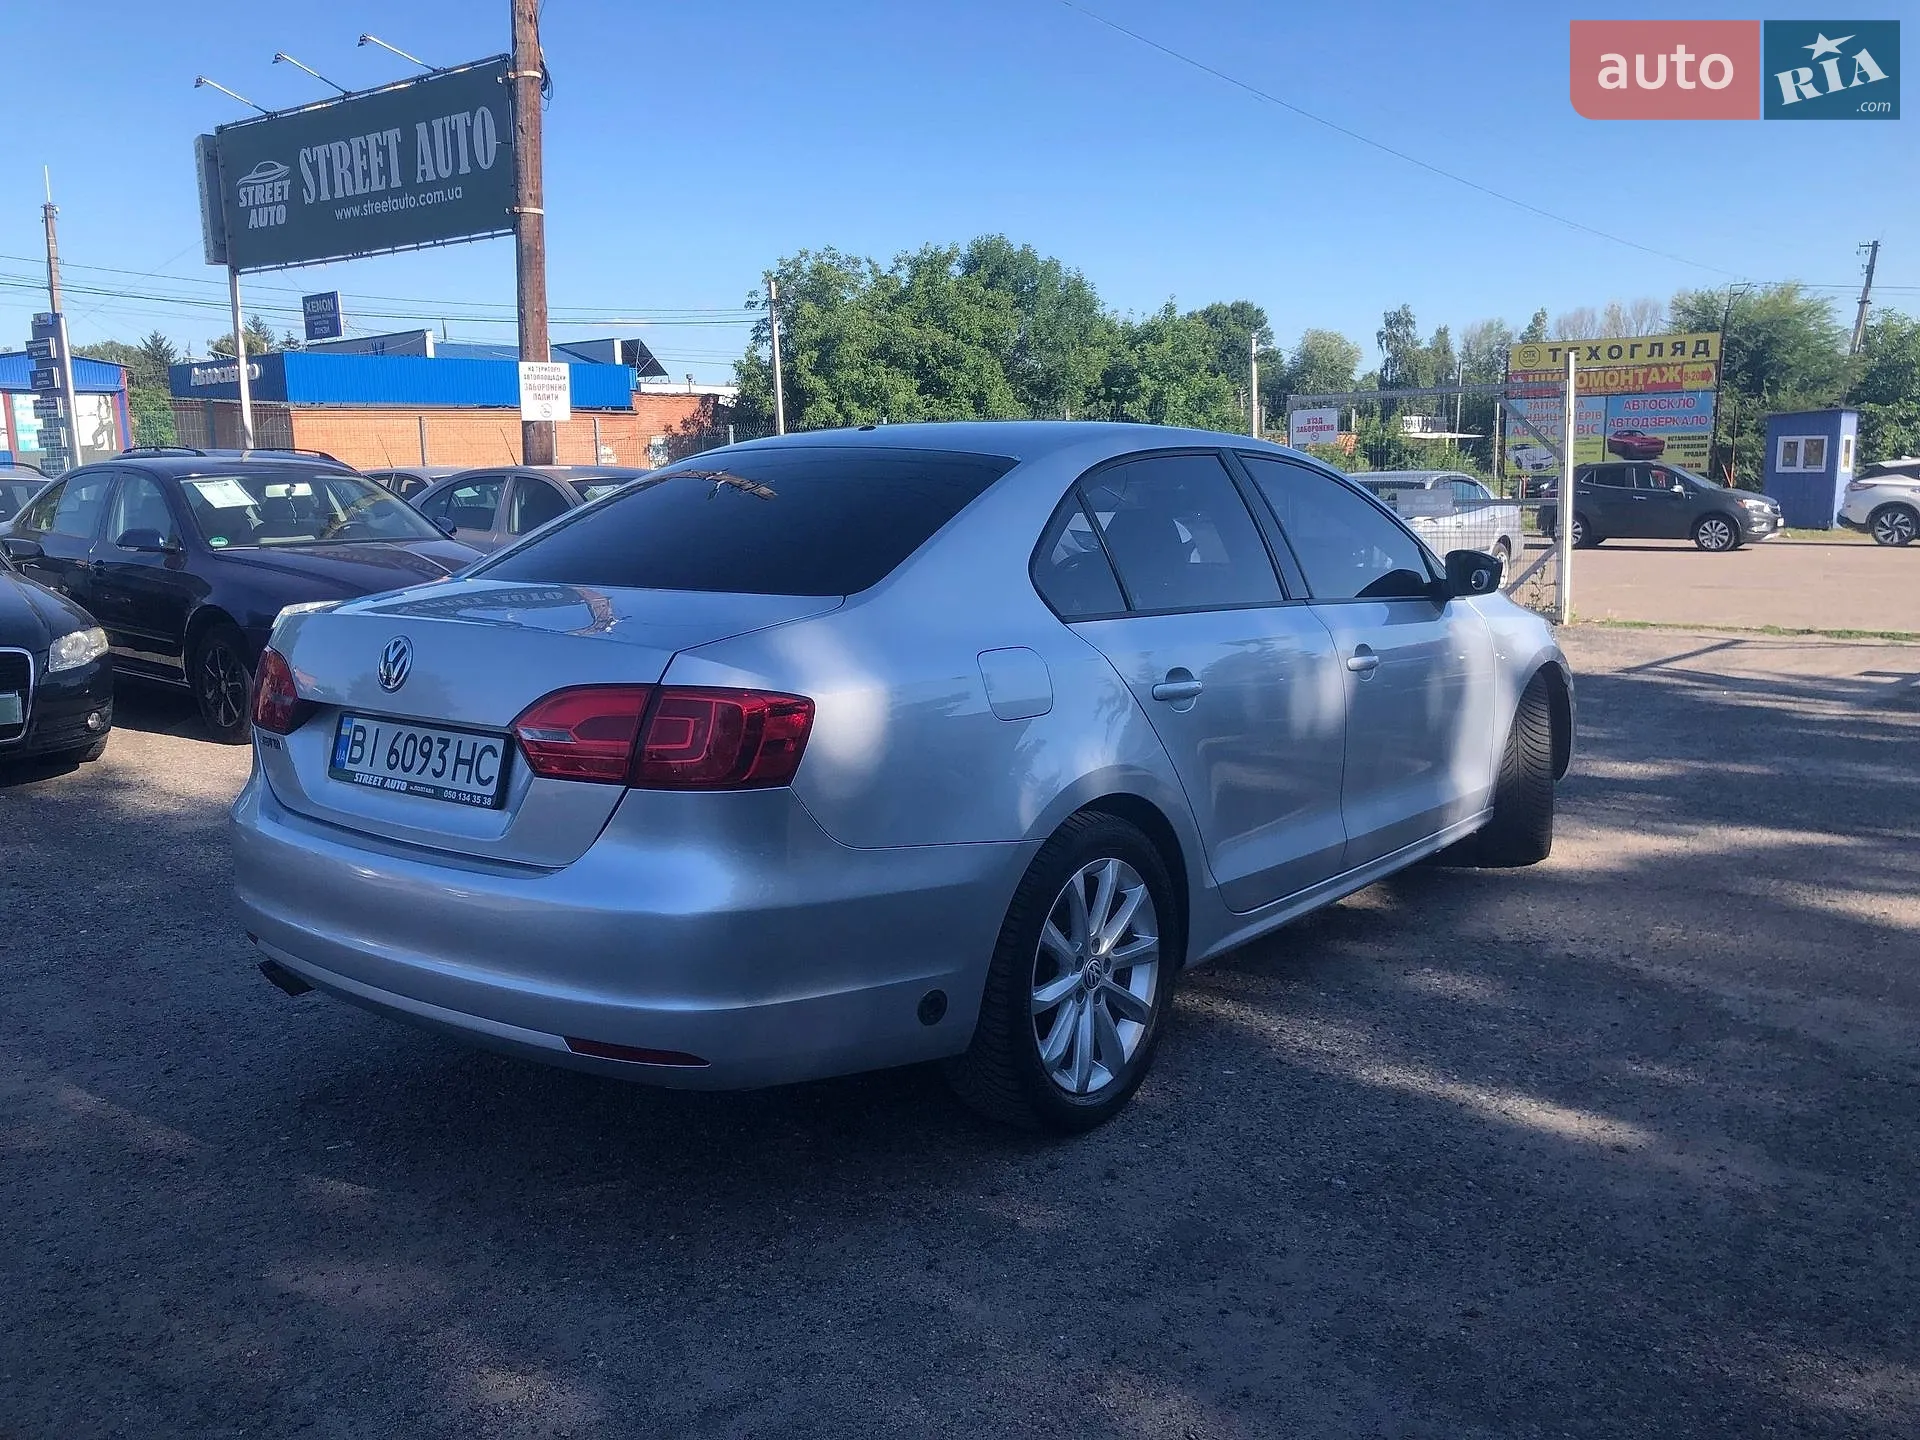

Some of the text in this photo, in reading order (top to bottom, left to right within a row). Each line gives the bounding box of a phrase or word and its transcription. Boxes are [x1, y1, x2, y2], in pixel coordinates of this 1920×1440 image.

[299, 128, 402, 205] STREET
[415, 106, 496, 184] AUTO
[238, 180, 290, 208] STREET
[335, 184, 462, 221] www.streetauto.com.ua
[248, 206, 287, 229] AUTO
[305, 298, 334, 314] XENON
[1548, 339, 1710, 362] ТЕХОГЛЯД
[523, 383, 567, 391] ЗАБОРОНЕНО
[533, 393, 559, 401] ПАЛИТИ
[1624, 397, 1696, 411] АВТОСКЛО
[1608, 415, 1708, 429] АВТОДЗЕРКАЛО
[335, 751, 345, 761] UA
[347, 724, 498, 787] BI 6093 HC
[353, 772, 408, 791] STREET AUTO
[443, 790, 493, 805] 050 134 35 38
